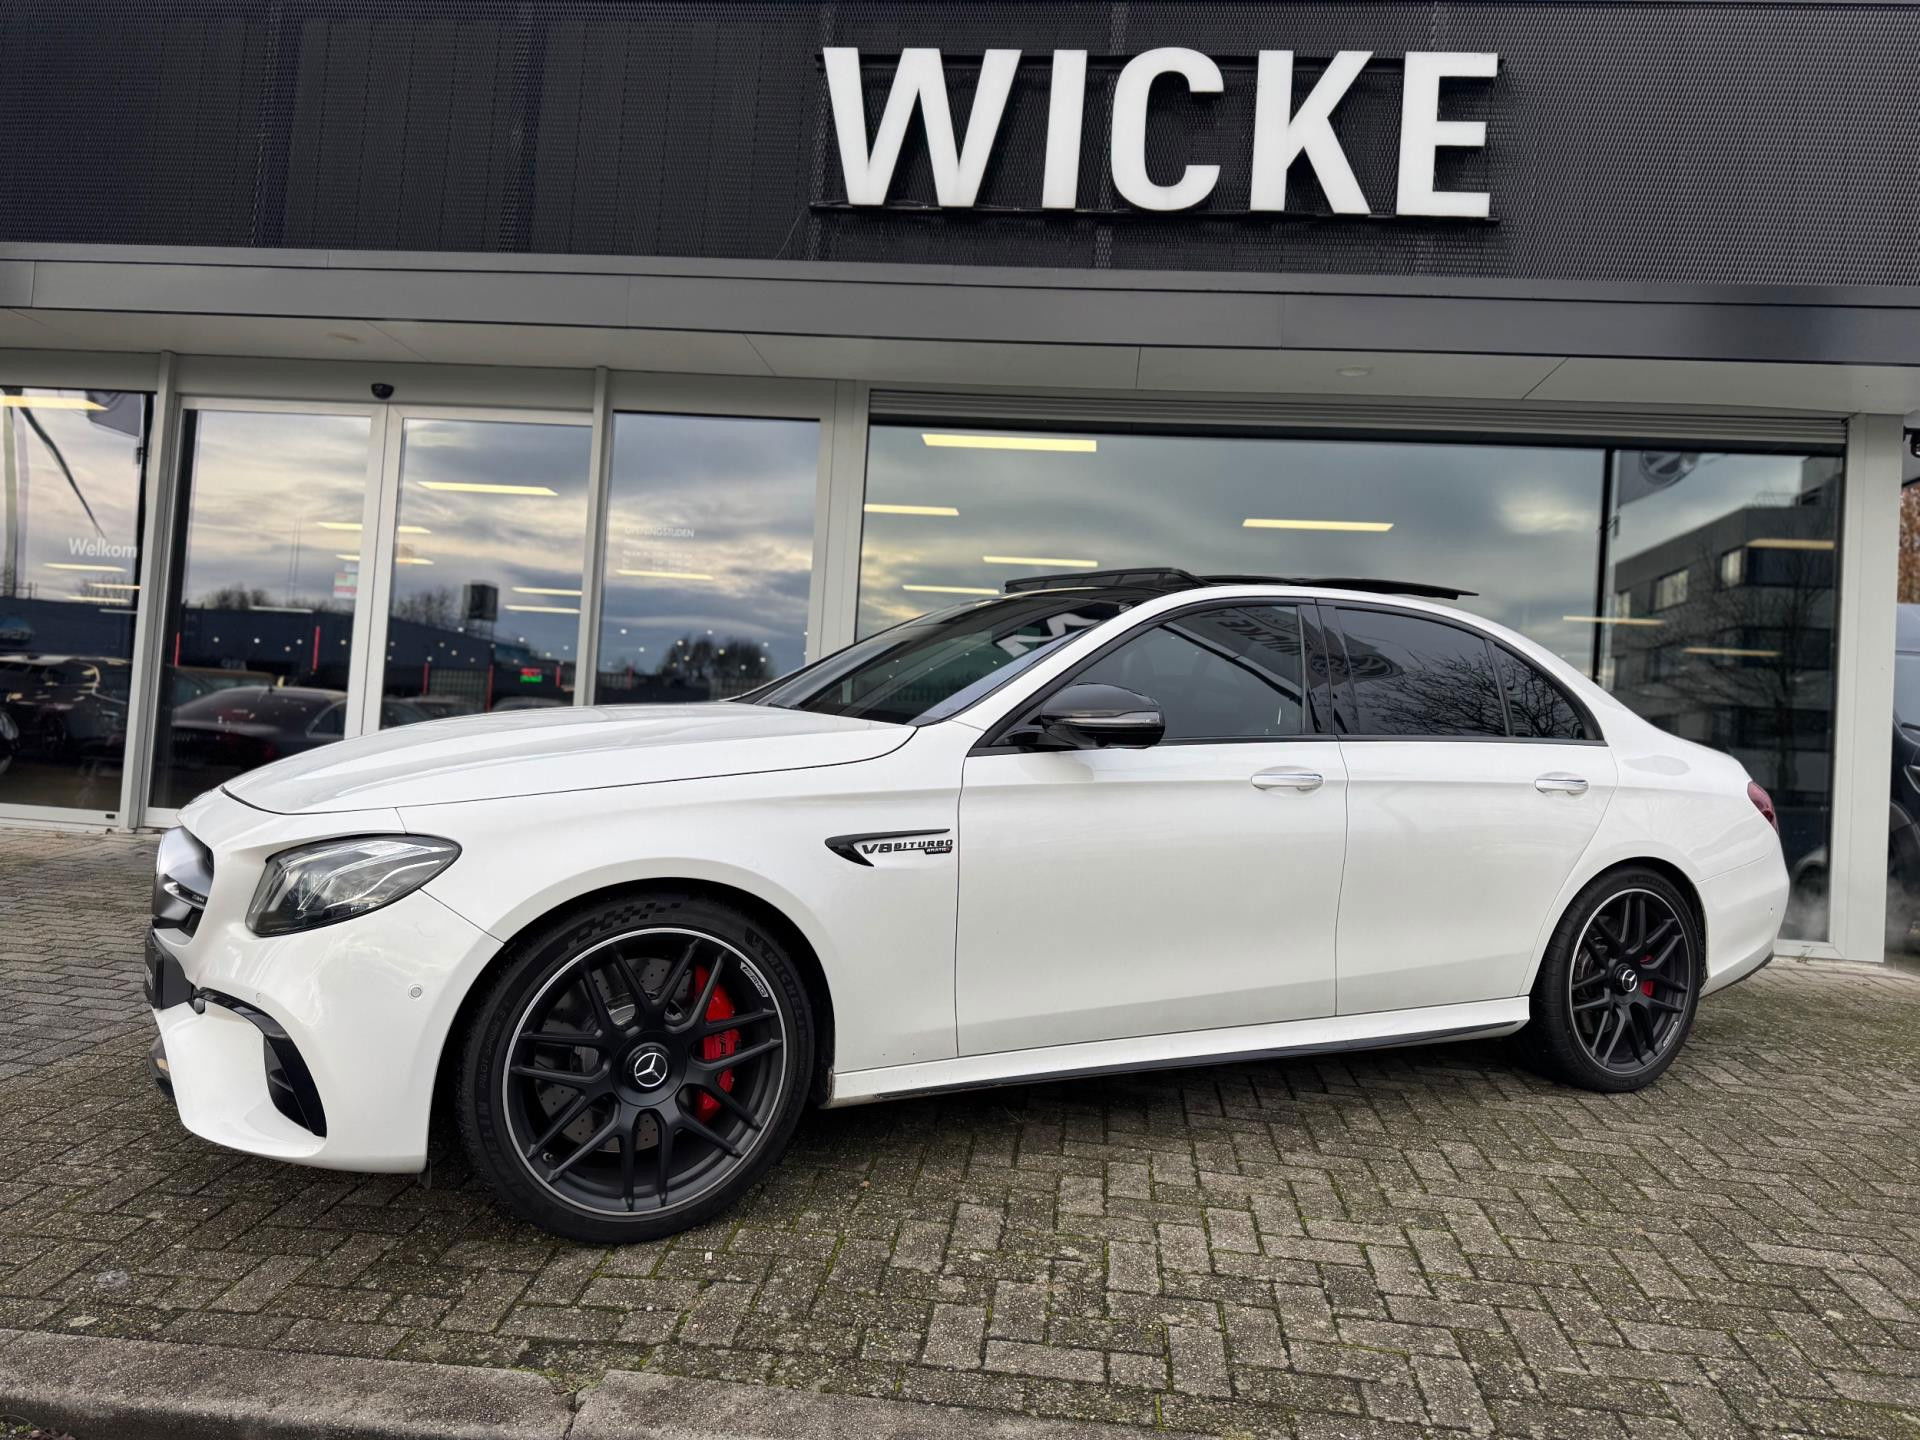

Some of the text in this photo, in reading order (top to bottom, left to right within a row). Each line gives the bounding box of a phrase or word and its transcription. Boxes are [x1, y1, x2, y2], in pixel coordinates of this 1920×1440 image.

[823, 46, 1499, 218] WICKE
[67, 536, 138, 558] Welkom
[764, 951, 808, 1040] MICHELIN
